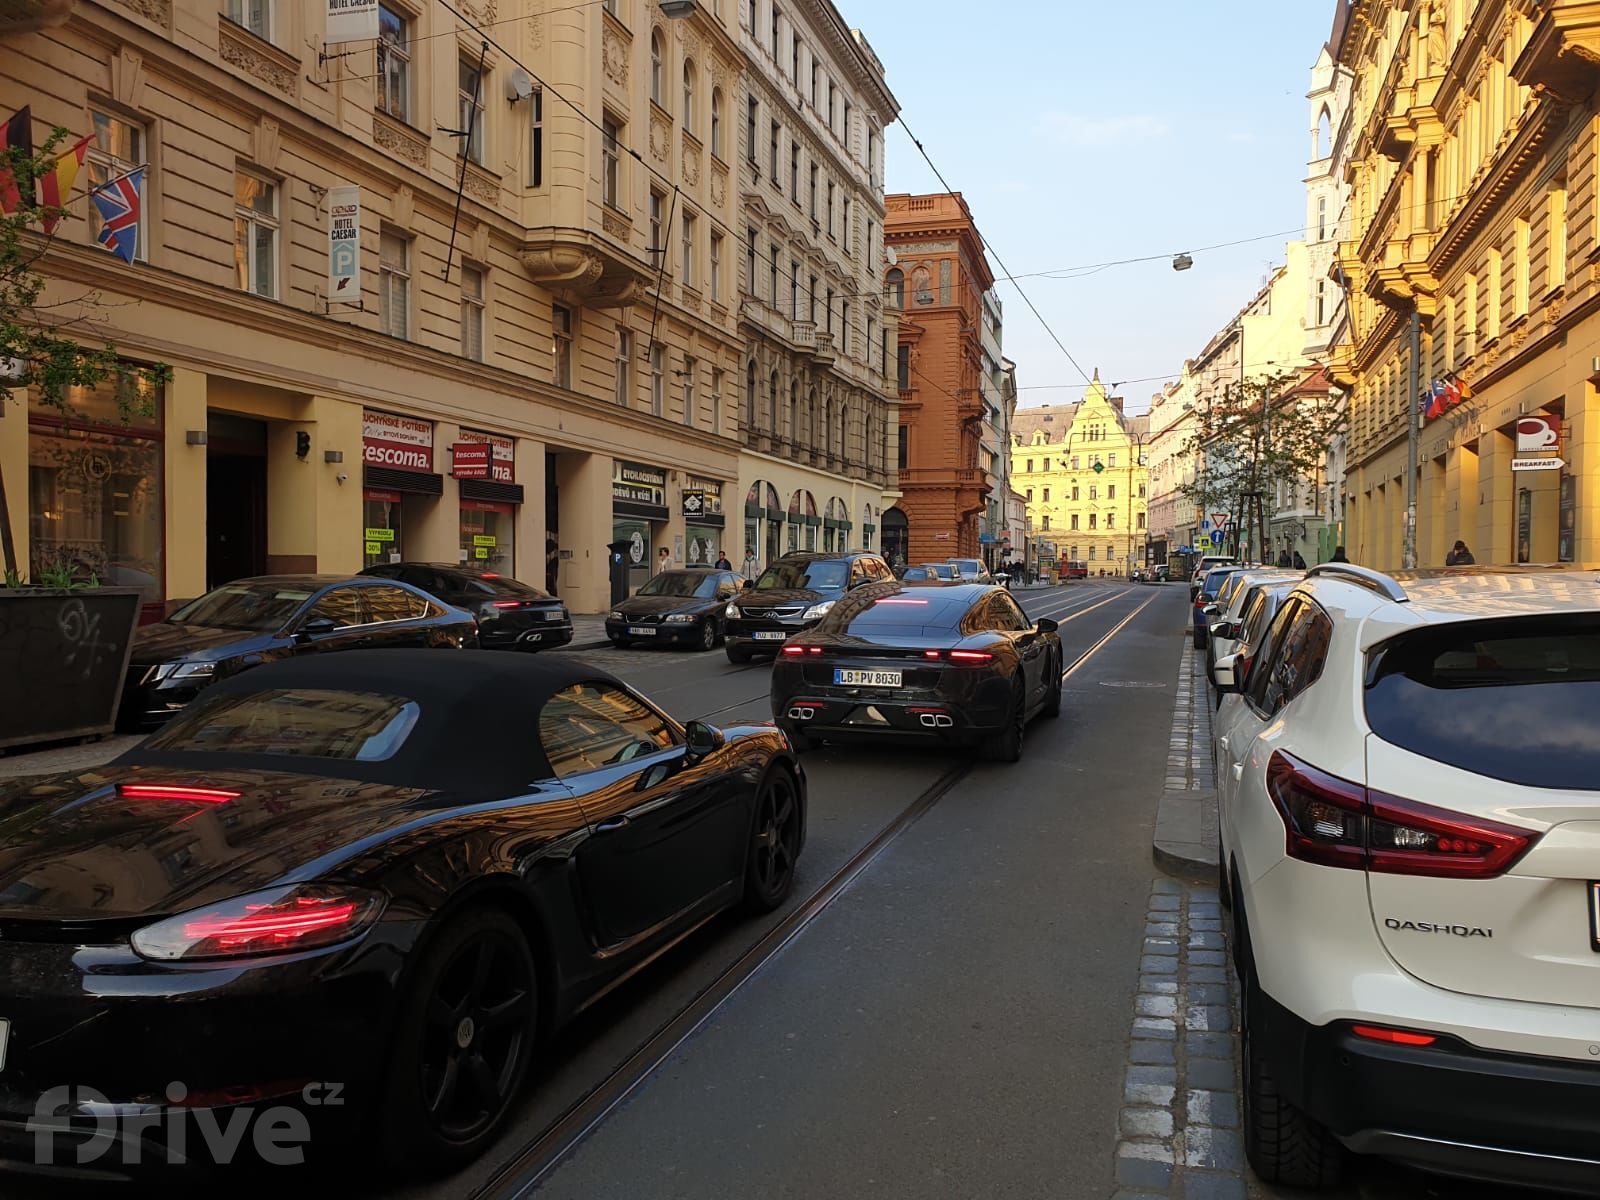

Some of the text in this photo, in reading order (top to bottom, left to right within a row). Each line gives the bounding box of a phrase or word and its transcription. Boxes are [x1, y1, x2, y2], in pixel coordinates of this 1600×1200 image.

[334, 218, 353, 229] HOTEL
[331, 228, 357, 240] CAESAR
[337, 250, 352, 273] P
[363, 412, 399, 428] UCHYŇSKÉ
[456, 451, 487, 459] tescoma.
[1514, 460, 1556, 468] BREAKFAST
[615, 553, 621, 562] P
[841, 671, 900, 685] LB PV 8030
[1385, 917, 1493, 938] QASHQAI
